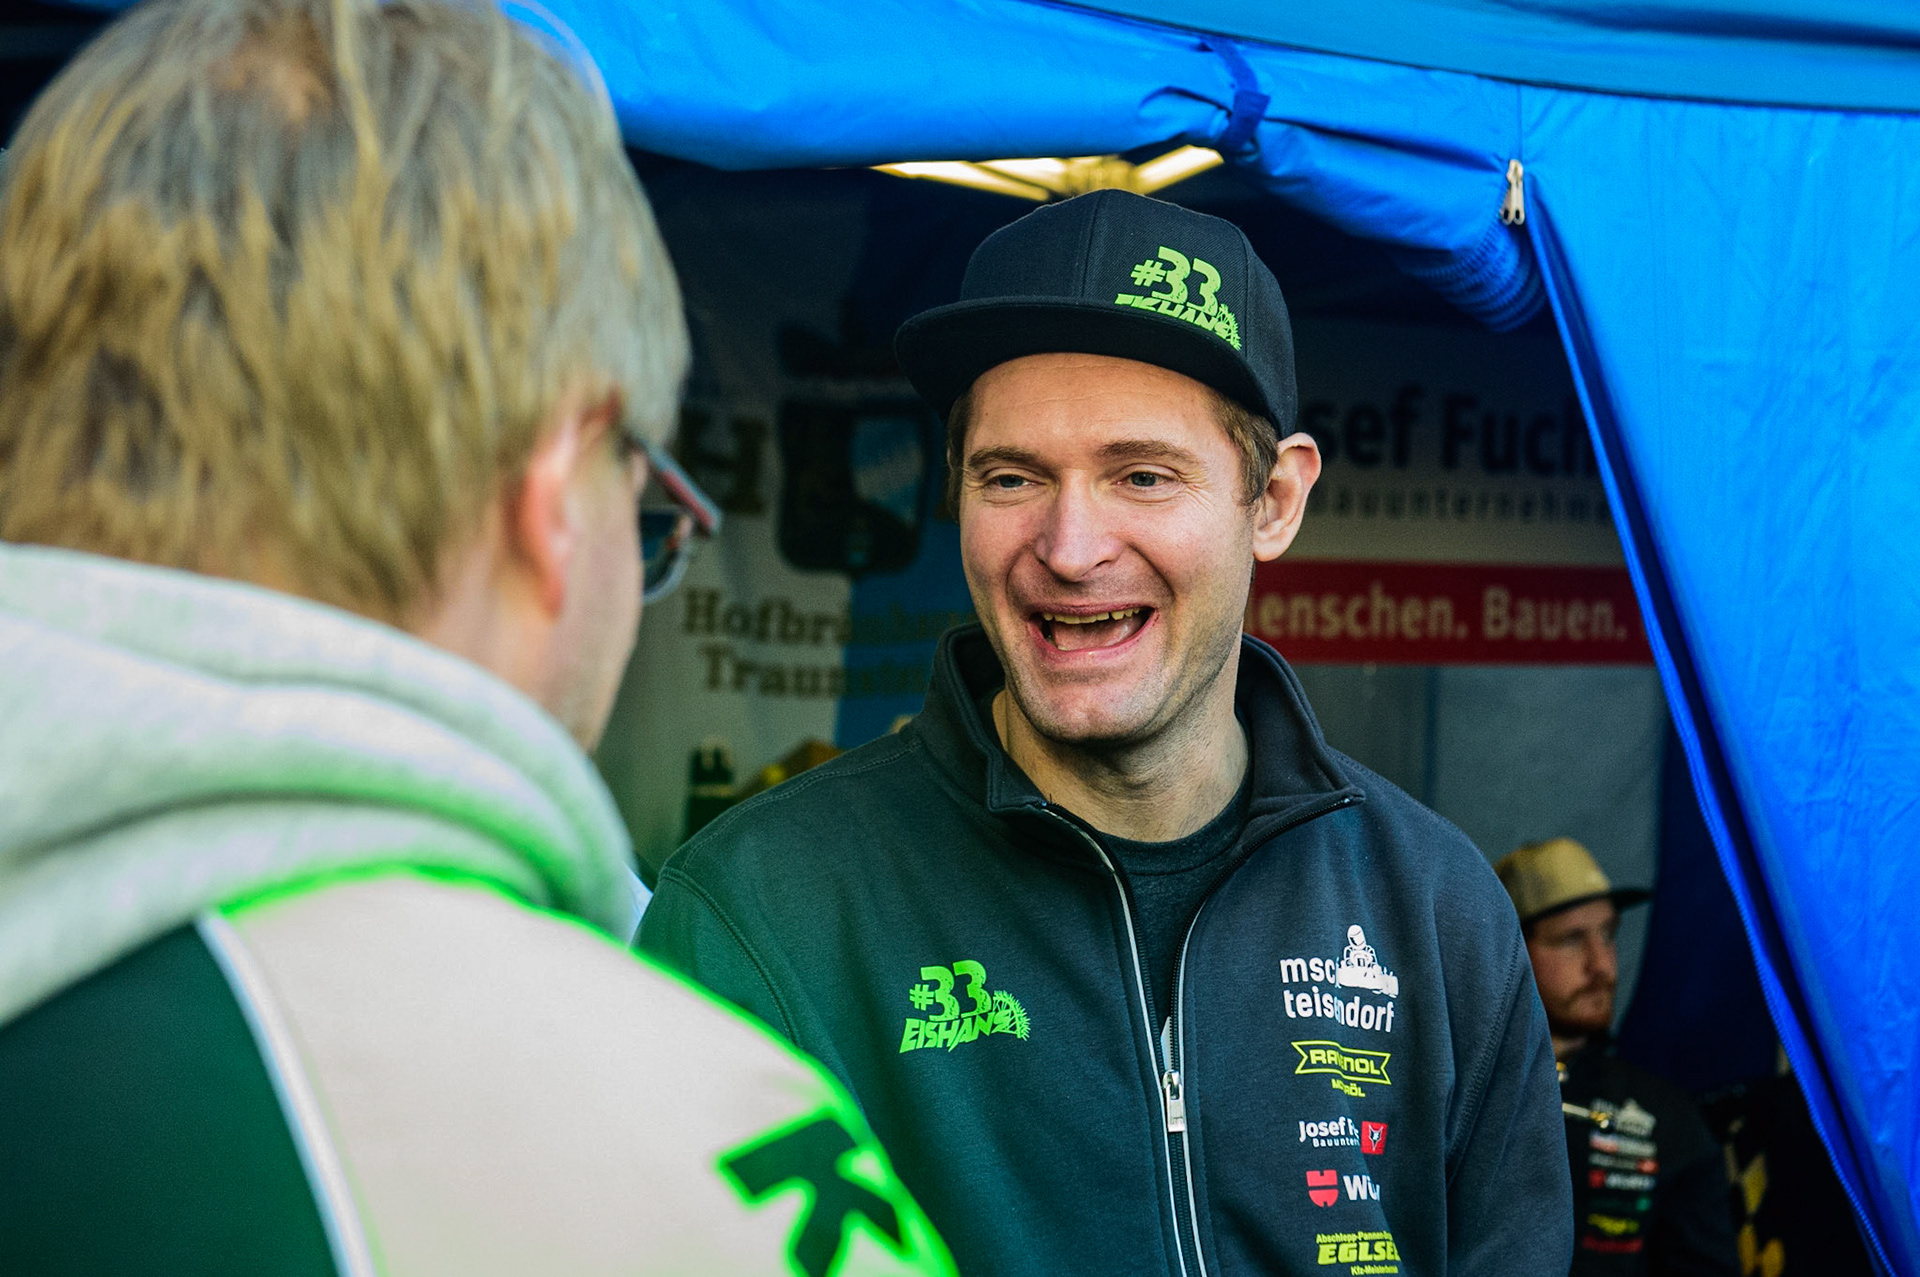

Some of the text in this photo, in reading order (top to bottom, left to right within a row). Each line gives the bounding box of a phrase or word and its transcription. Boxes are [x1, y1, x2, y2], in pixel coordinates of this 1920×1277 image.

[1130, 246, 1222, 316] #33
[1301, 386, 1597, 475] sef Fuch
[1483, 586, 1628, 641] Bauen.
[909, 959, 993, 1022] #33
[1298, 1116, 1346, 1143] Josef
